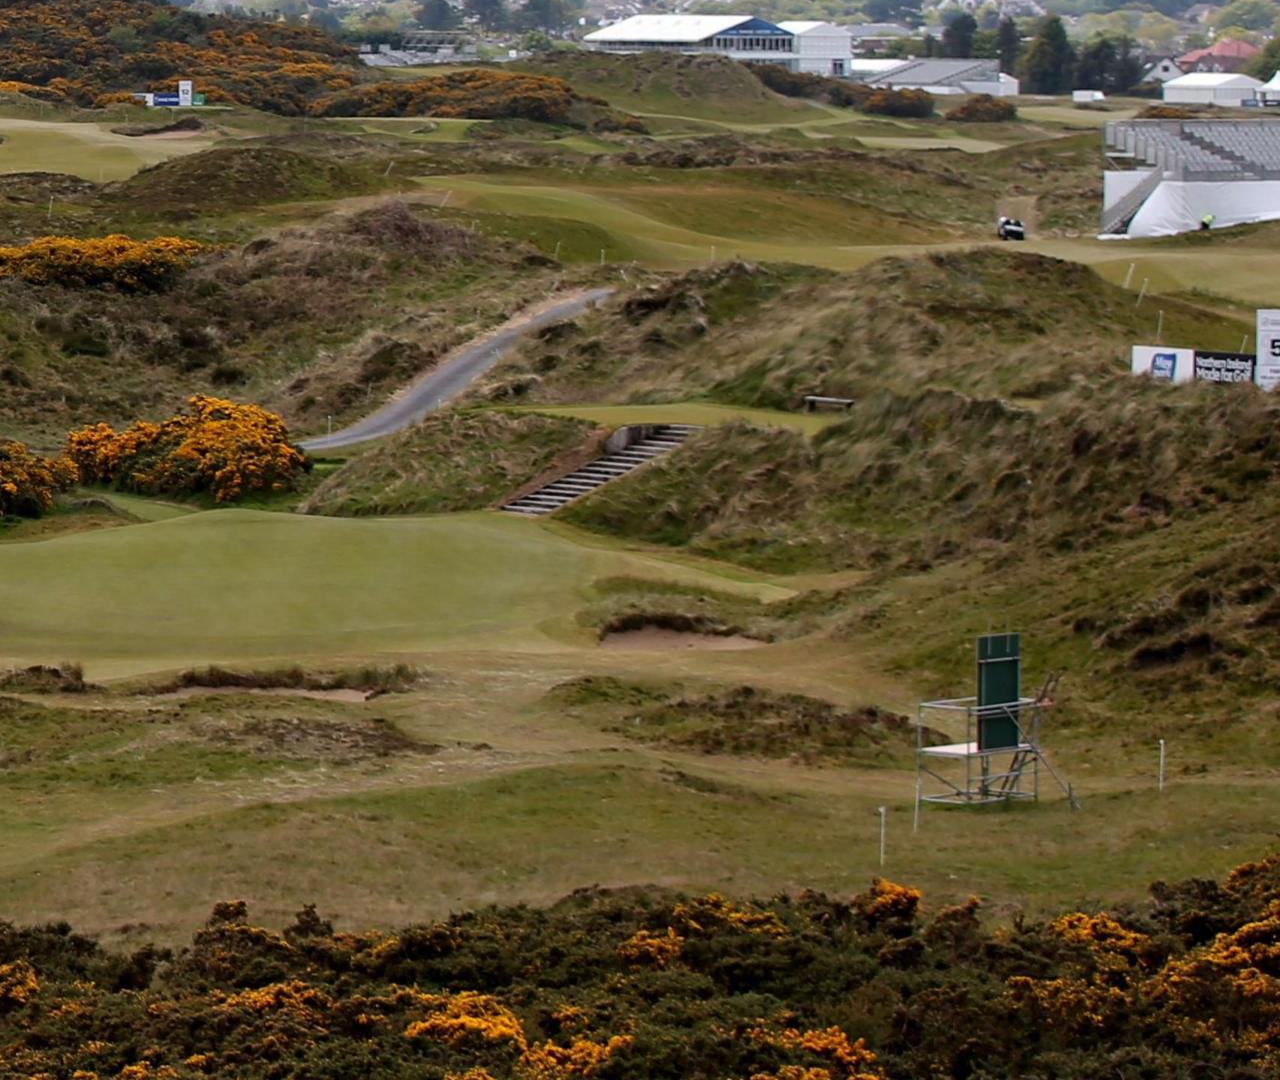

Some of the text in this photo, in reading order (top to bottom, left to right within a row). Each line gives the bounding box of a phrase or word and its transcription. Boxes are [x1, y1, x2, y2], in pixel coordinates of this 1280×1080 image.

[1196, 357, 1252, 370] Northern Ireland
[1196, 367, 1252, 383] Made for Golf
